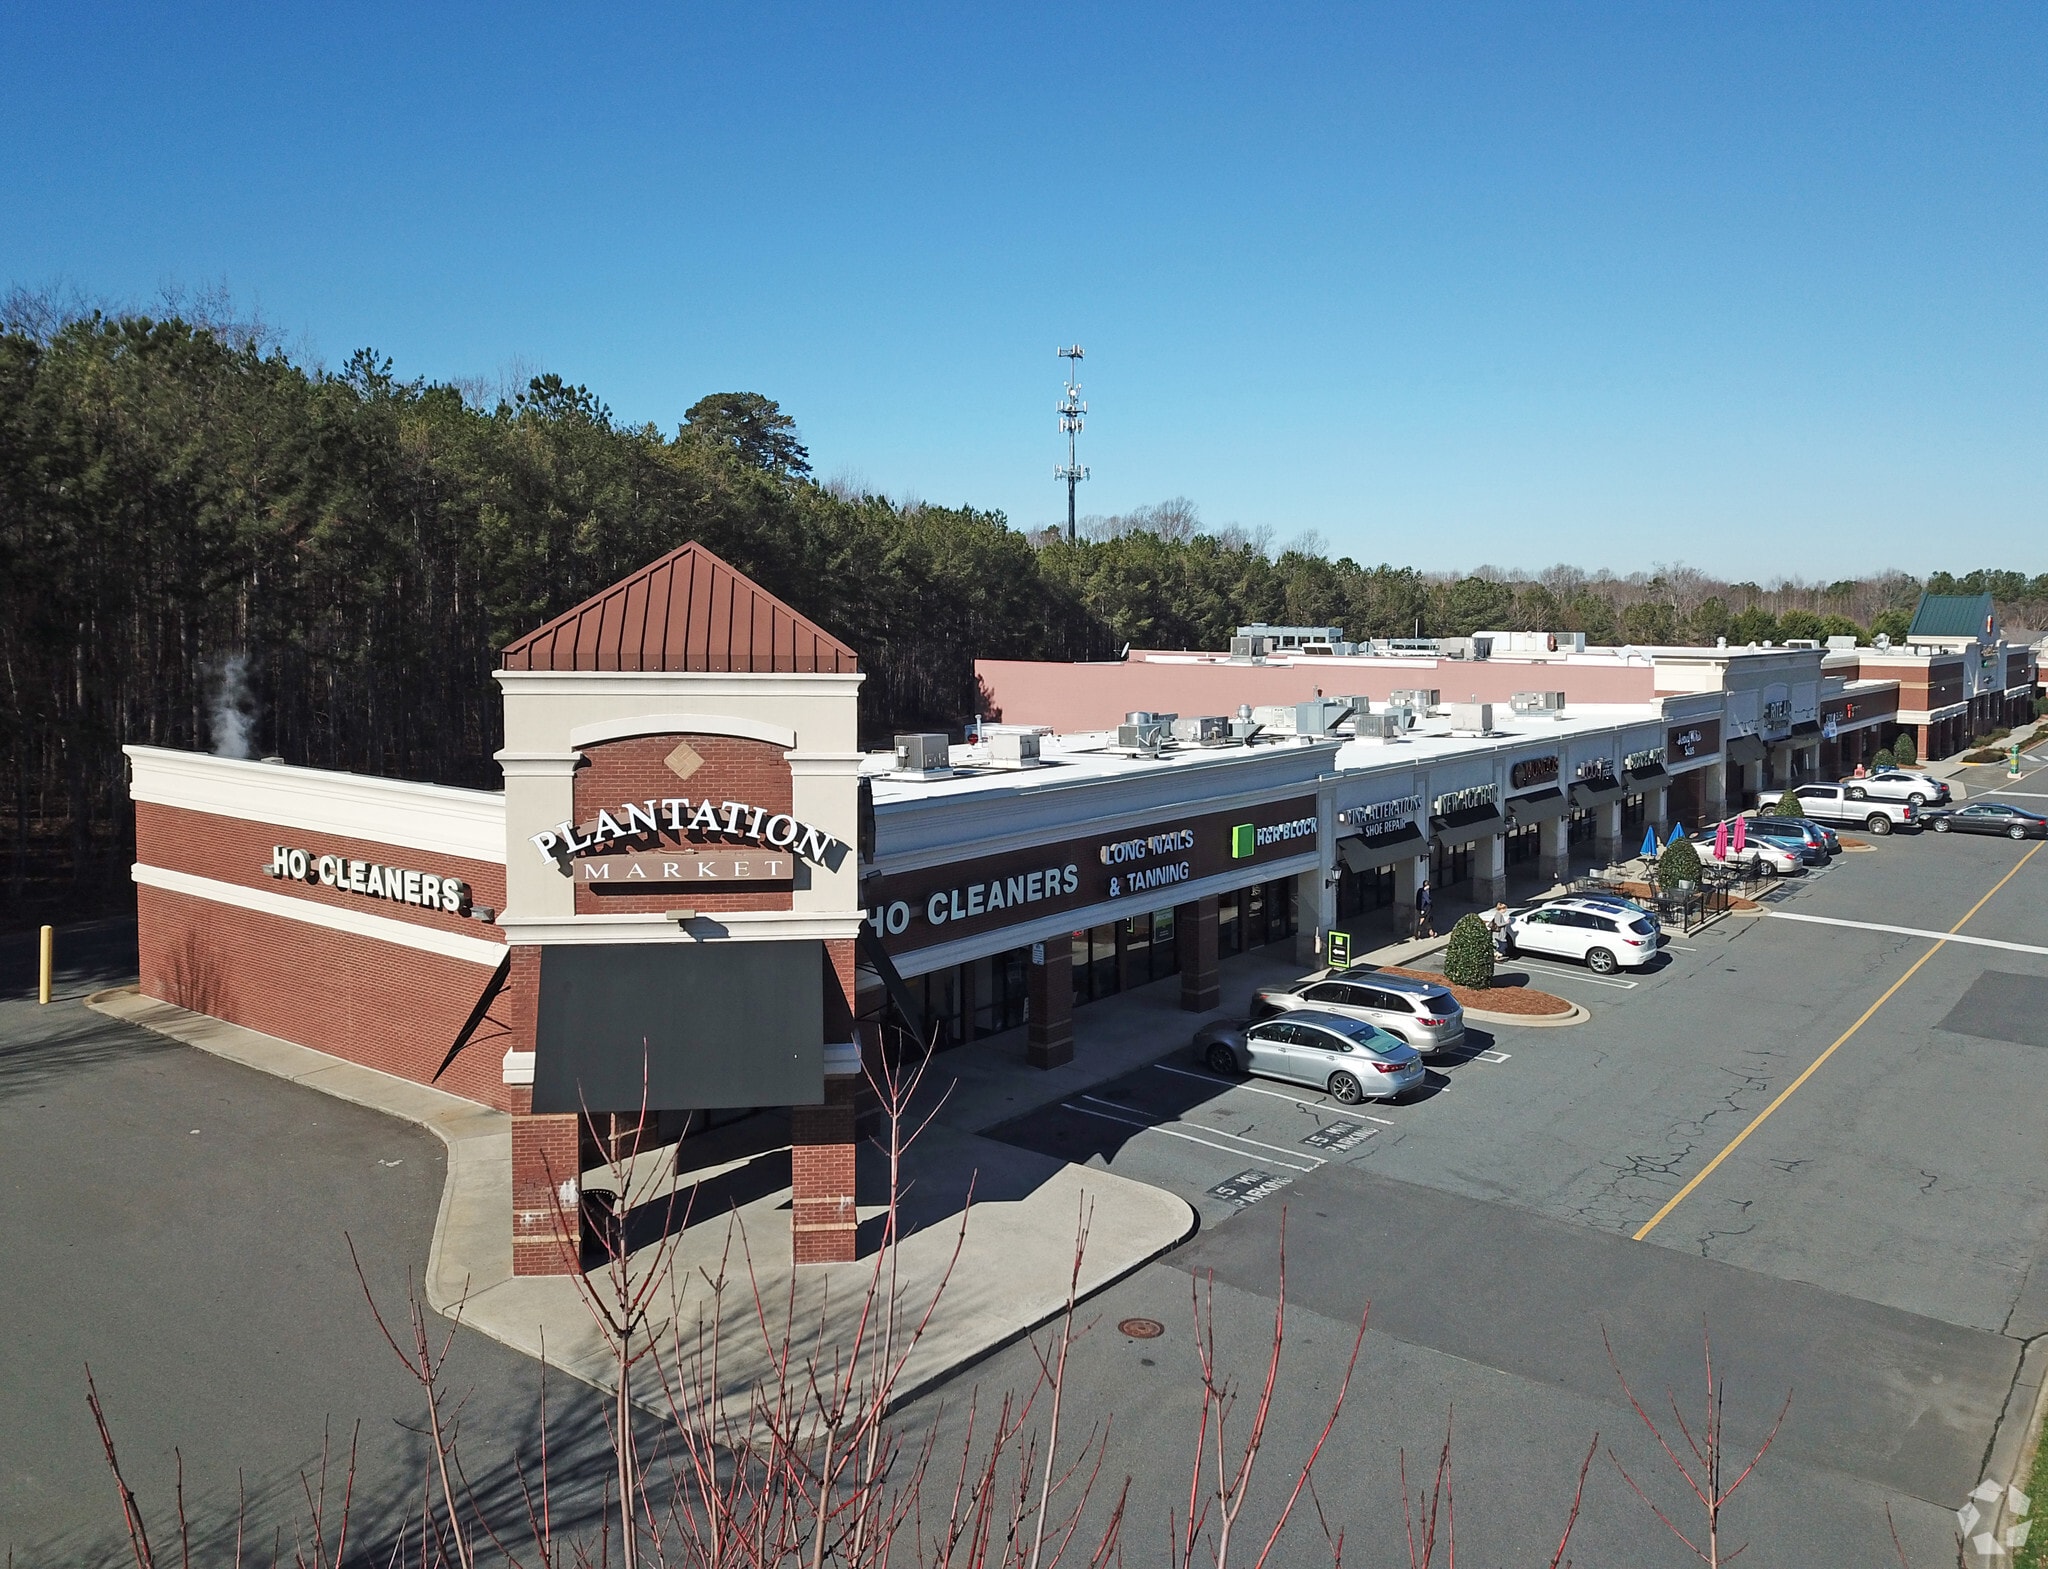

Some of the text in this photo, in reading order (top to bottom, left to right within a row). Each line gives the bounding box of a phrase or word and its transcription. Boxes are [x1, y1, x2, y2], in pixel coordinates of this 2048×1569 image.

[1369, 796, 1422, 821] ALTERATIONS
[1442, 794, 1460, 815] NEW
[1462, 789, 1479, 810] AGE
[528, 798, 840, 865] PLANTATION
[1257, 818, 1317, 847] H&R BLOCK
[1365, 818, 1407, 838] SHOE REPAIR
[1105, 829, 1194, 865] LONG NAILS
[273, 846, 461, 912] HO CLEANERS
[584, 860, 783, 880] MARKET
[1109, 861, 1190, 897] & TANNING
[867, 864, 1079, 938] HO CLEANERS
